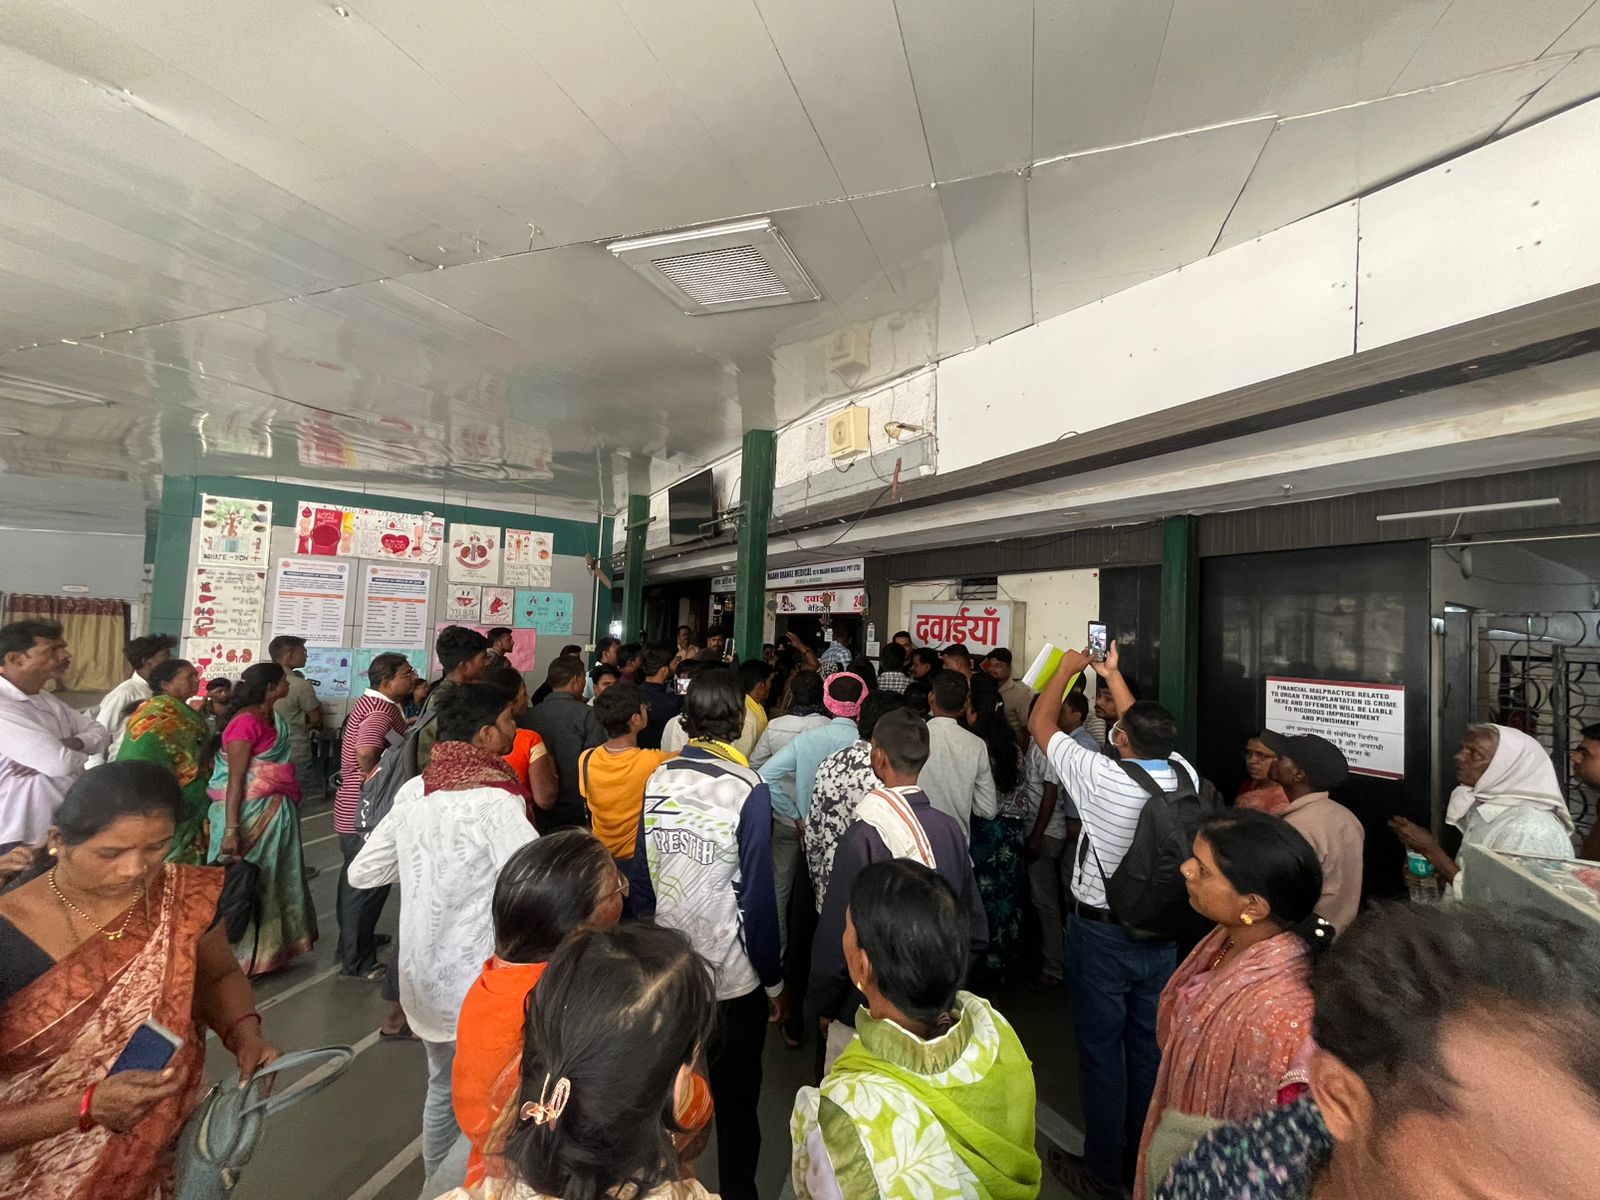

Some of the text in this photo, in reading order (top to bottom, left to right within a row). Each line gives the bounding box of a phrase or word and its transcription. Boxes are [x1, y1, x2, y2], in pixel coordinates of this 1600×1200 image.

[795, 568, 812, 577] MEDICAL
[916, 606, 1000, 646] दवाईयाँ
[1277, 685, 1389, 700] FINANCIAL MALPRACTICE RELATED
[1302, 695, 1362, 705] TRANSPLANTATION
[1374, 700, 1397, 708] CRIME
[1305, 702, 1337, 710] OFFENDER
[1294, 707, 1325, 716] RIGOROUS
[1327, 710, 1380, 721] IMPRISONMENT
[1316, 717, 1360, 726] PUNISHMENT
